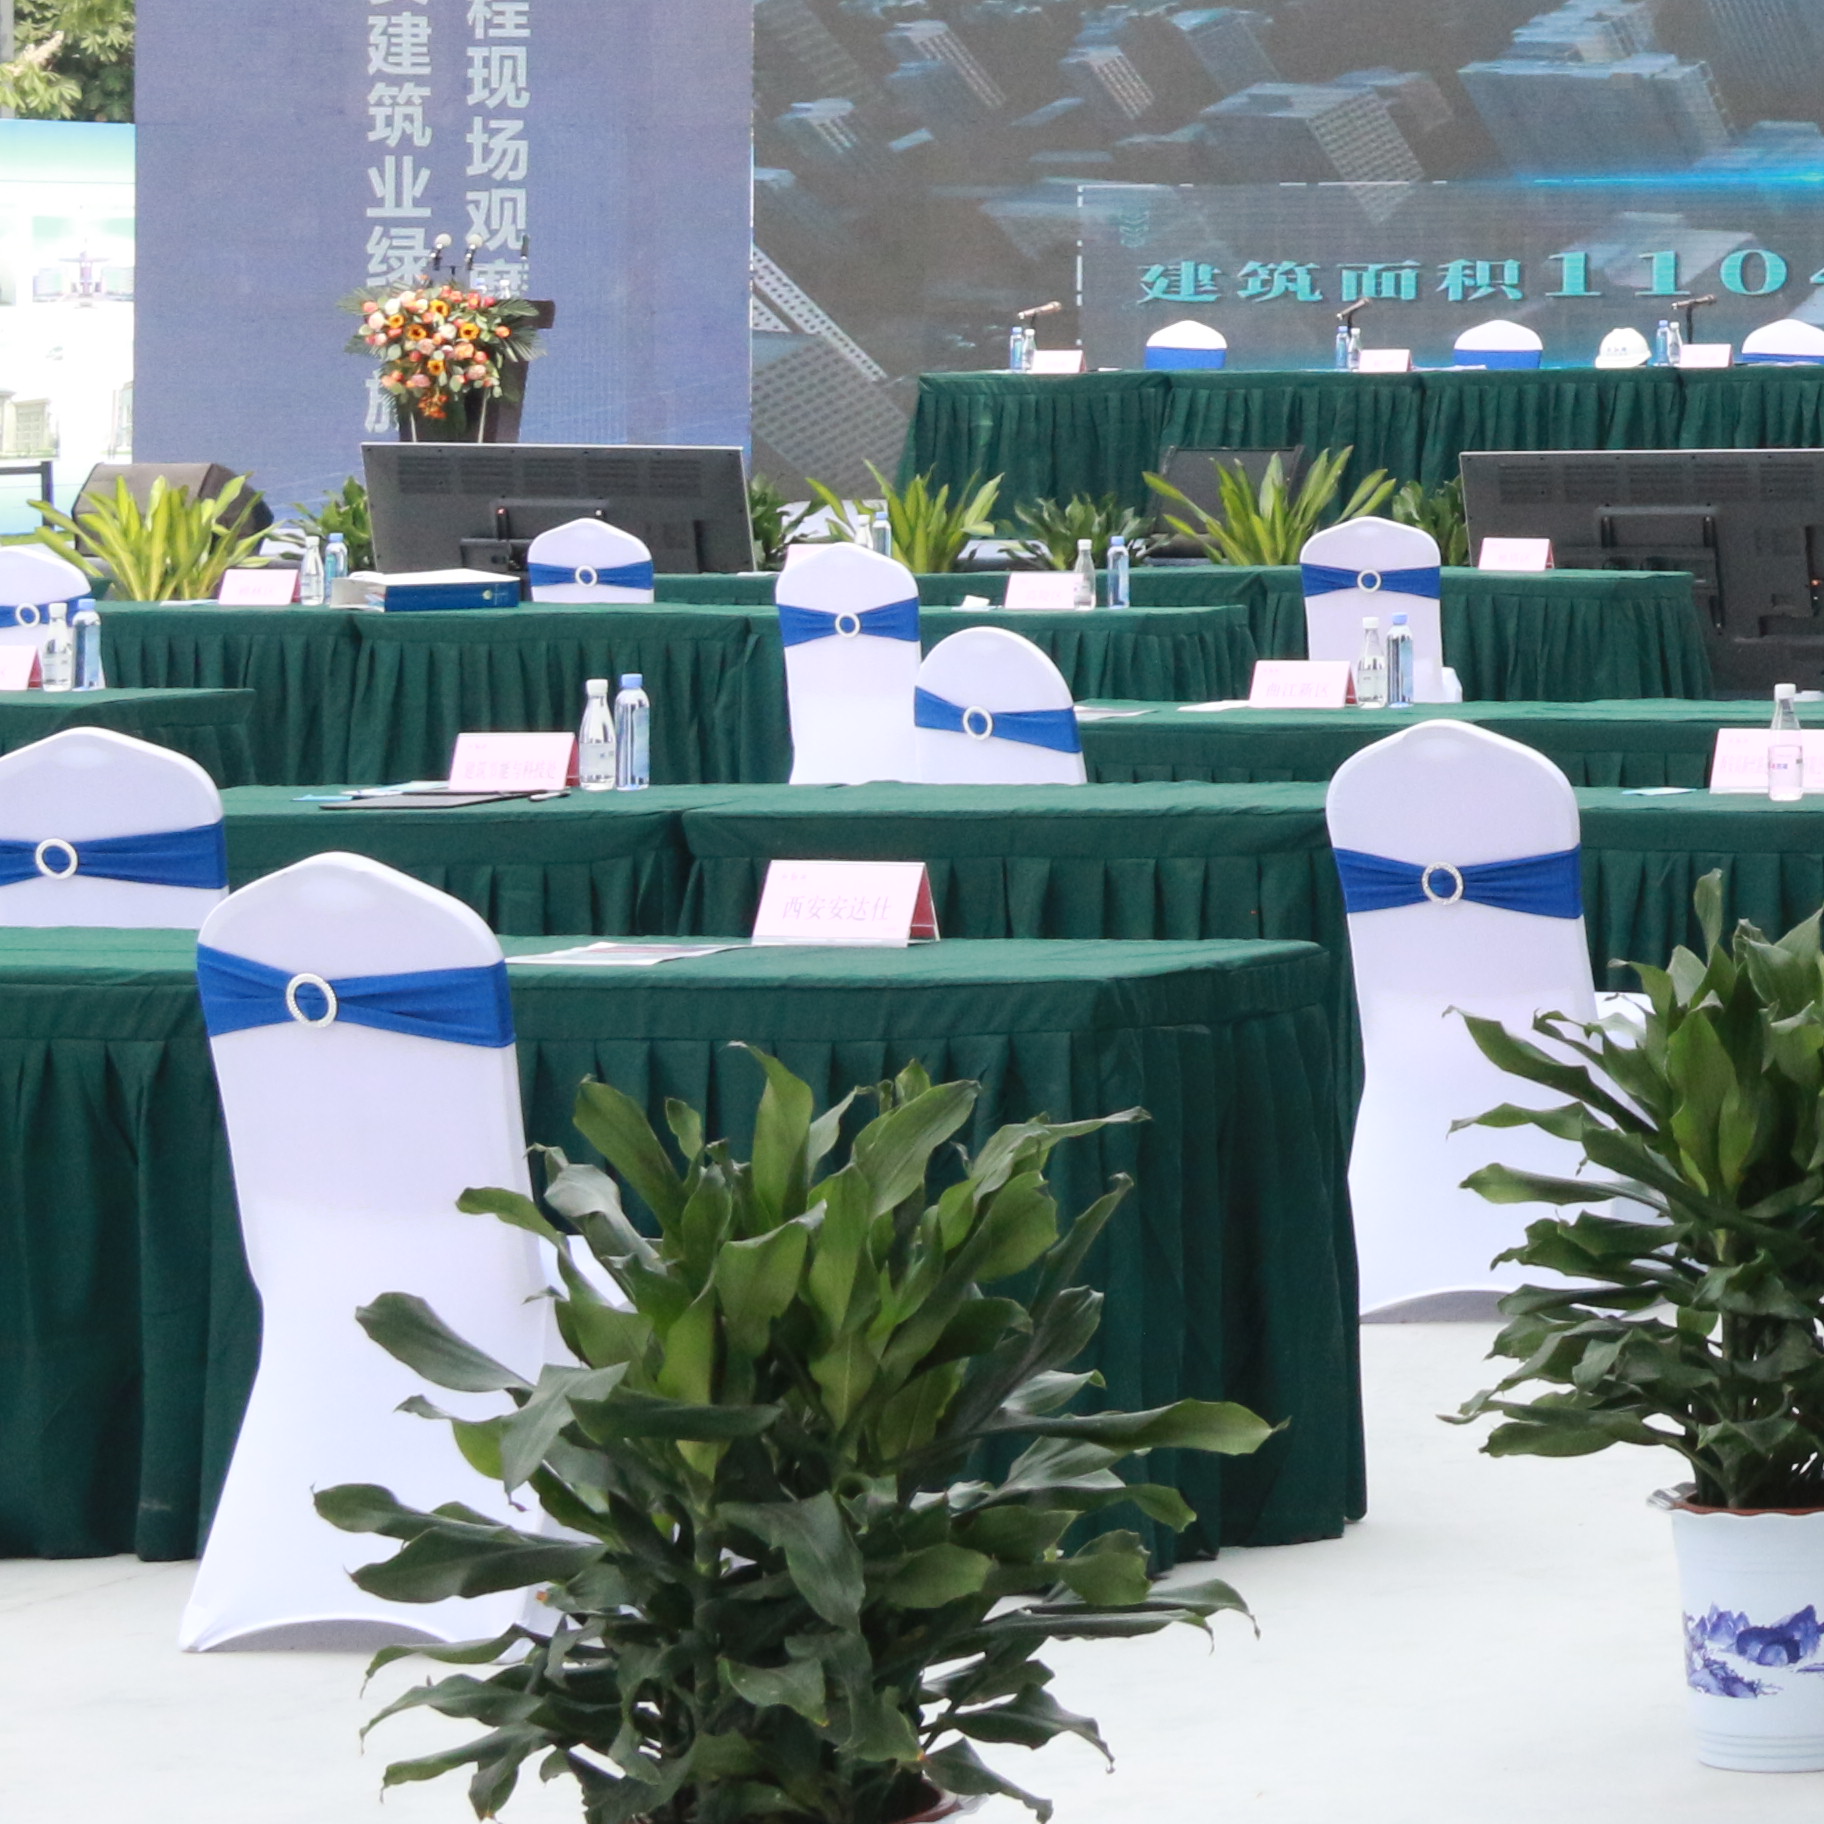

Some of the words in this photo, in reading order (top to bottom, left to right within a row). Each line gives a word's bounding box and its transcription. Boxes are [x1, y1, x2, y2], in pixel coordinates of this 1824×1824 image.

[1264, 680, 1330, 699] 曲江新区
[781, 894, 893, 922] 西安安达仕
